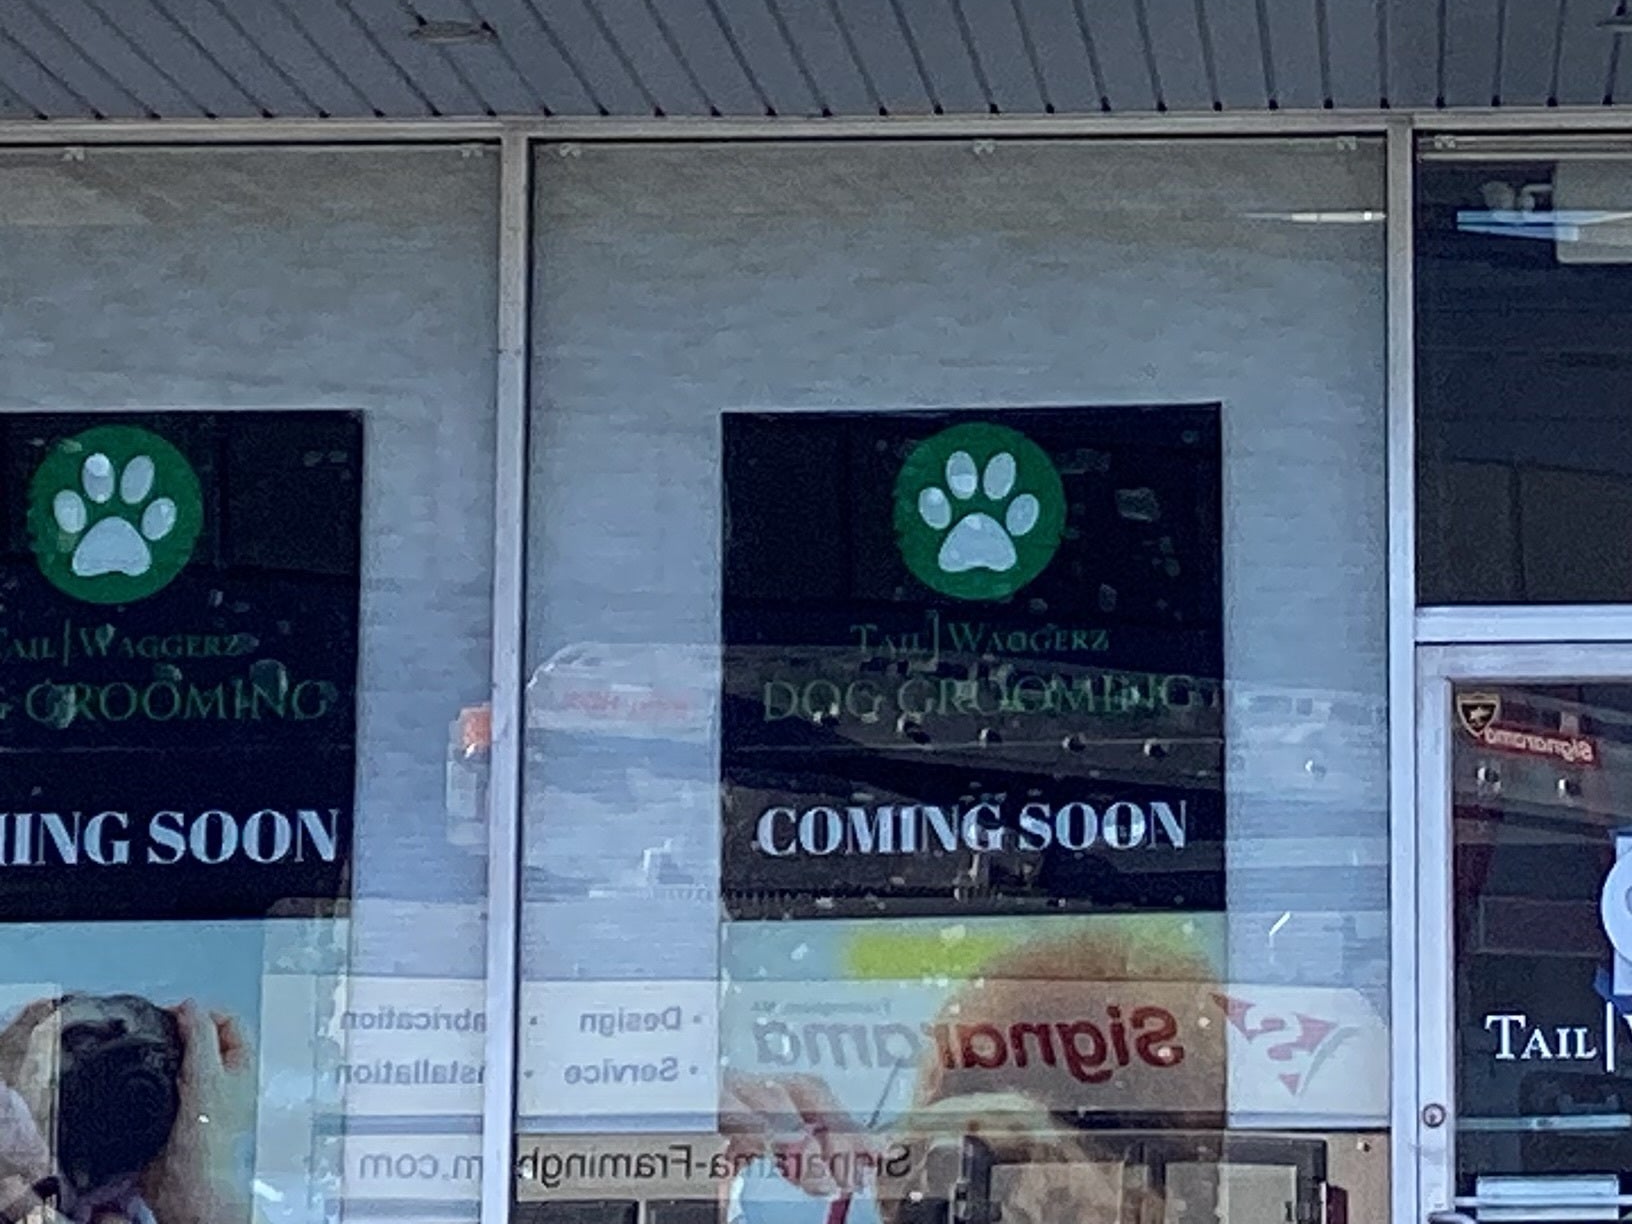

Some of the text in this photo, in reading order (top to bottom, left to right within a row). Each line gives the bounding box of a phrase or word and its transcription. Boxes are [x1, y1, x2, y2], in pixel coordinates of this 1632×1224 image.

[11, 624, 241, 659] AIL WAGGERZ
[25, 680, 329, 721] GROOMING
[763, 679, 883, 722] DOG
[899, 674, 1196, 716] GROOMING
[0, 809, 341, 866] ING SOON
[756, 799, 1187, 856] COMING SOON
[1484, 1014, 1597, 1060] TAIL
